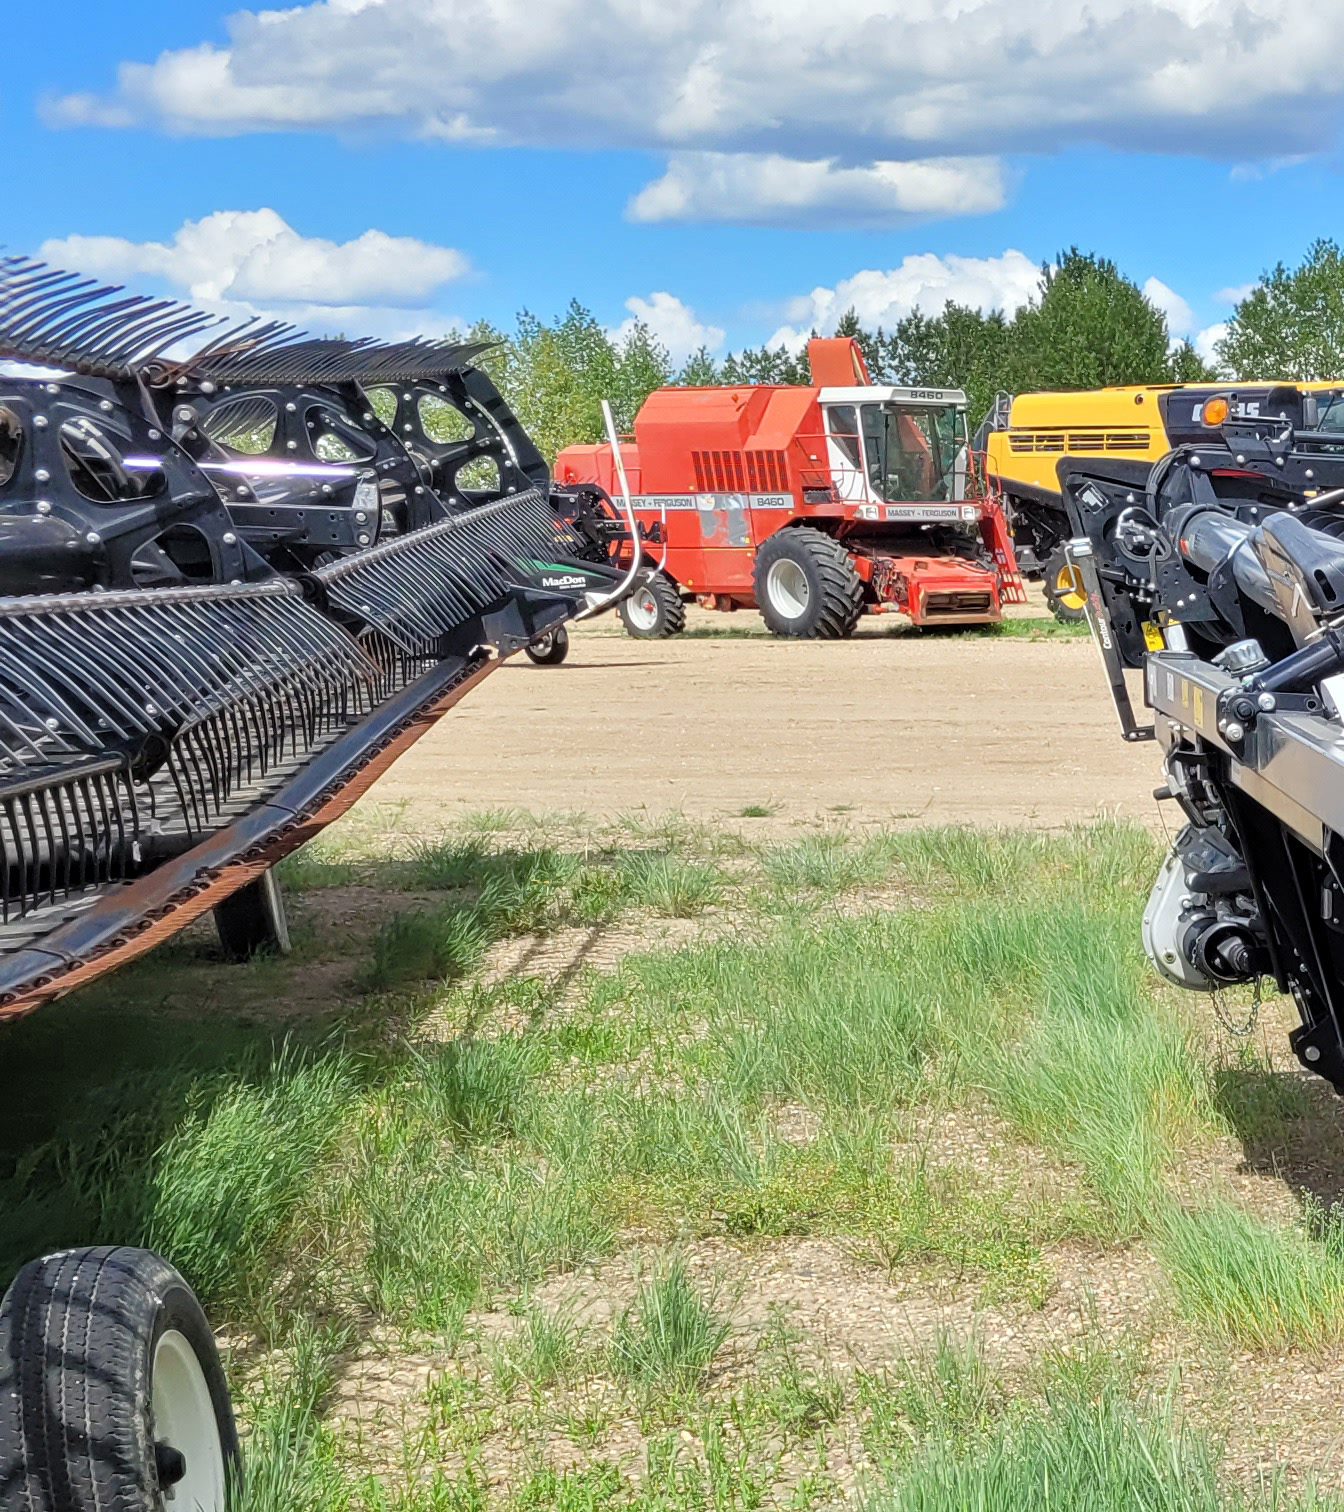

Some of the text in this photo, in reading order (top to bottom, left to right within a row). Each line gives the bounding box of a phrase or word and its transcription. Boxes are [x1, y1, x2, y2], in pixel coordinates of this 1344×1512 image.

[910, 390, 943, 400] 8460
[757, 497, 785, 507] 8460
[887, 509, 916, 517] MASSEY
[921, 509, 957, 517] FERGUSON
[542, 575, 586, 587] MacDon
